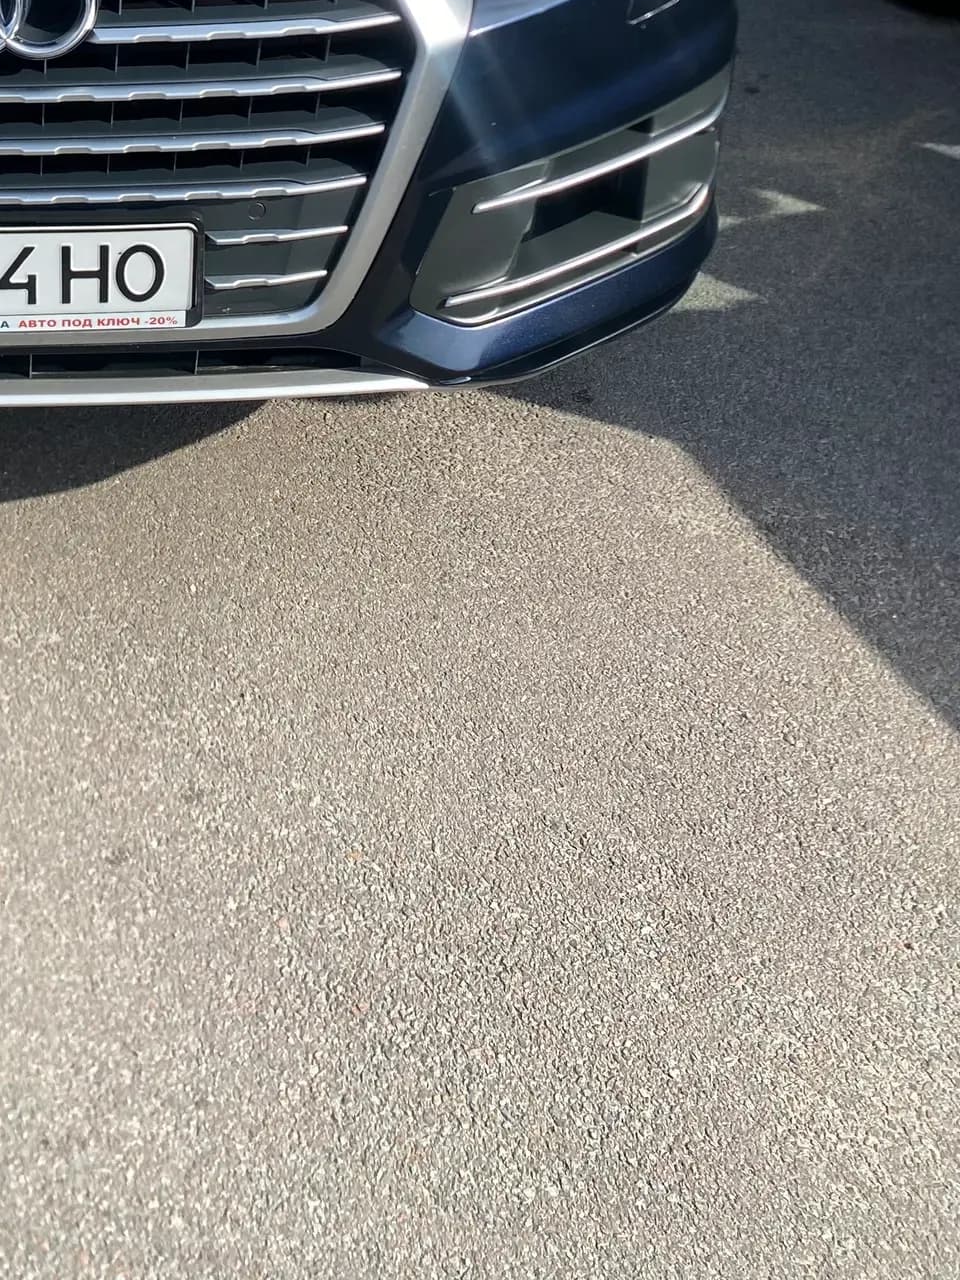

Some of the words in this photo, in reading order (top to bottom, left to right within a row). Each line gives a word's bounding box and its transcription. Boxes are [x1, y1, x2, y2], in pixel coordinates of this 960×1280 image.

[60, 243, 166, 305] HO
[18, 318, 57, 329] АВТО
[61, 317, 92, 329] ПОД
[97, 316, 140, 327] КЛЮЧ
[144, 315, 179, 326] -20%
